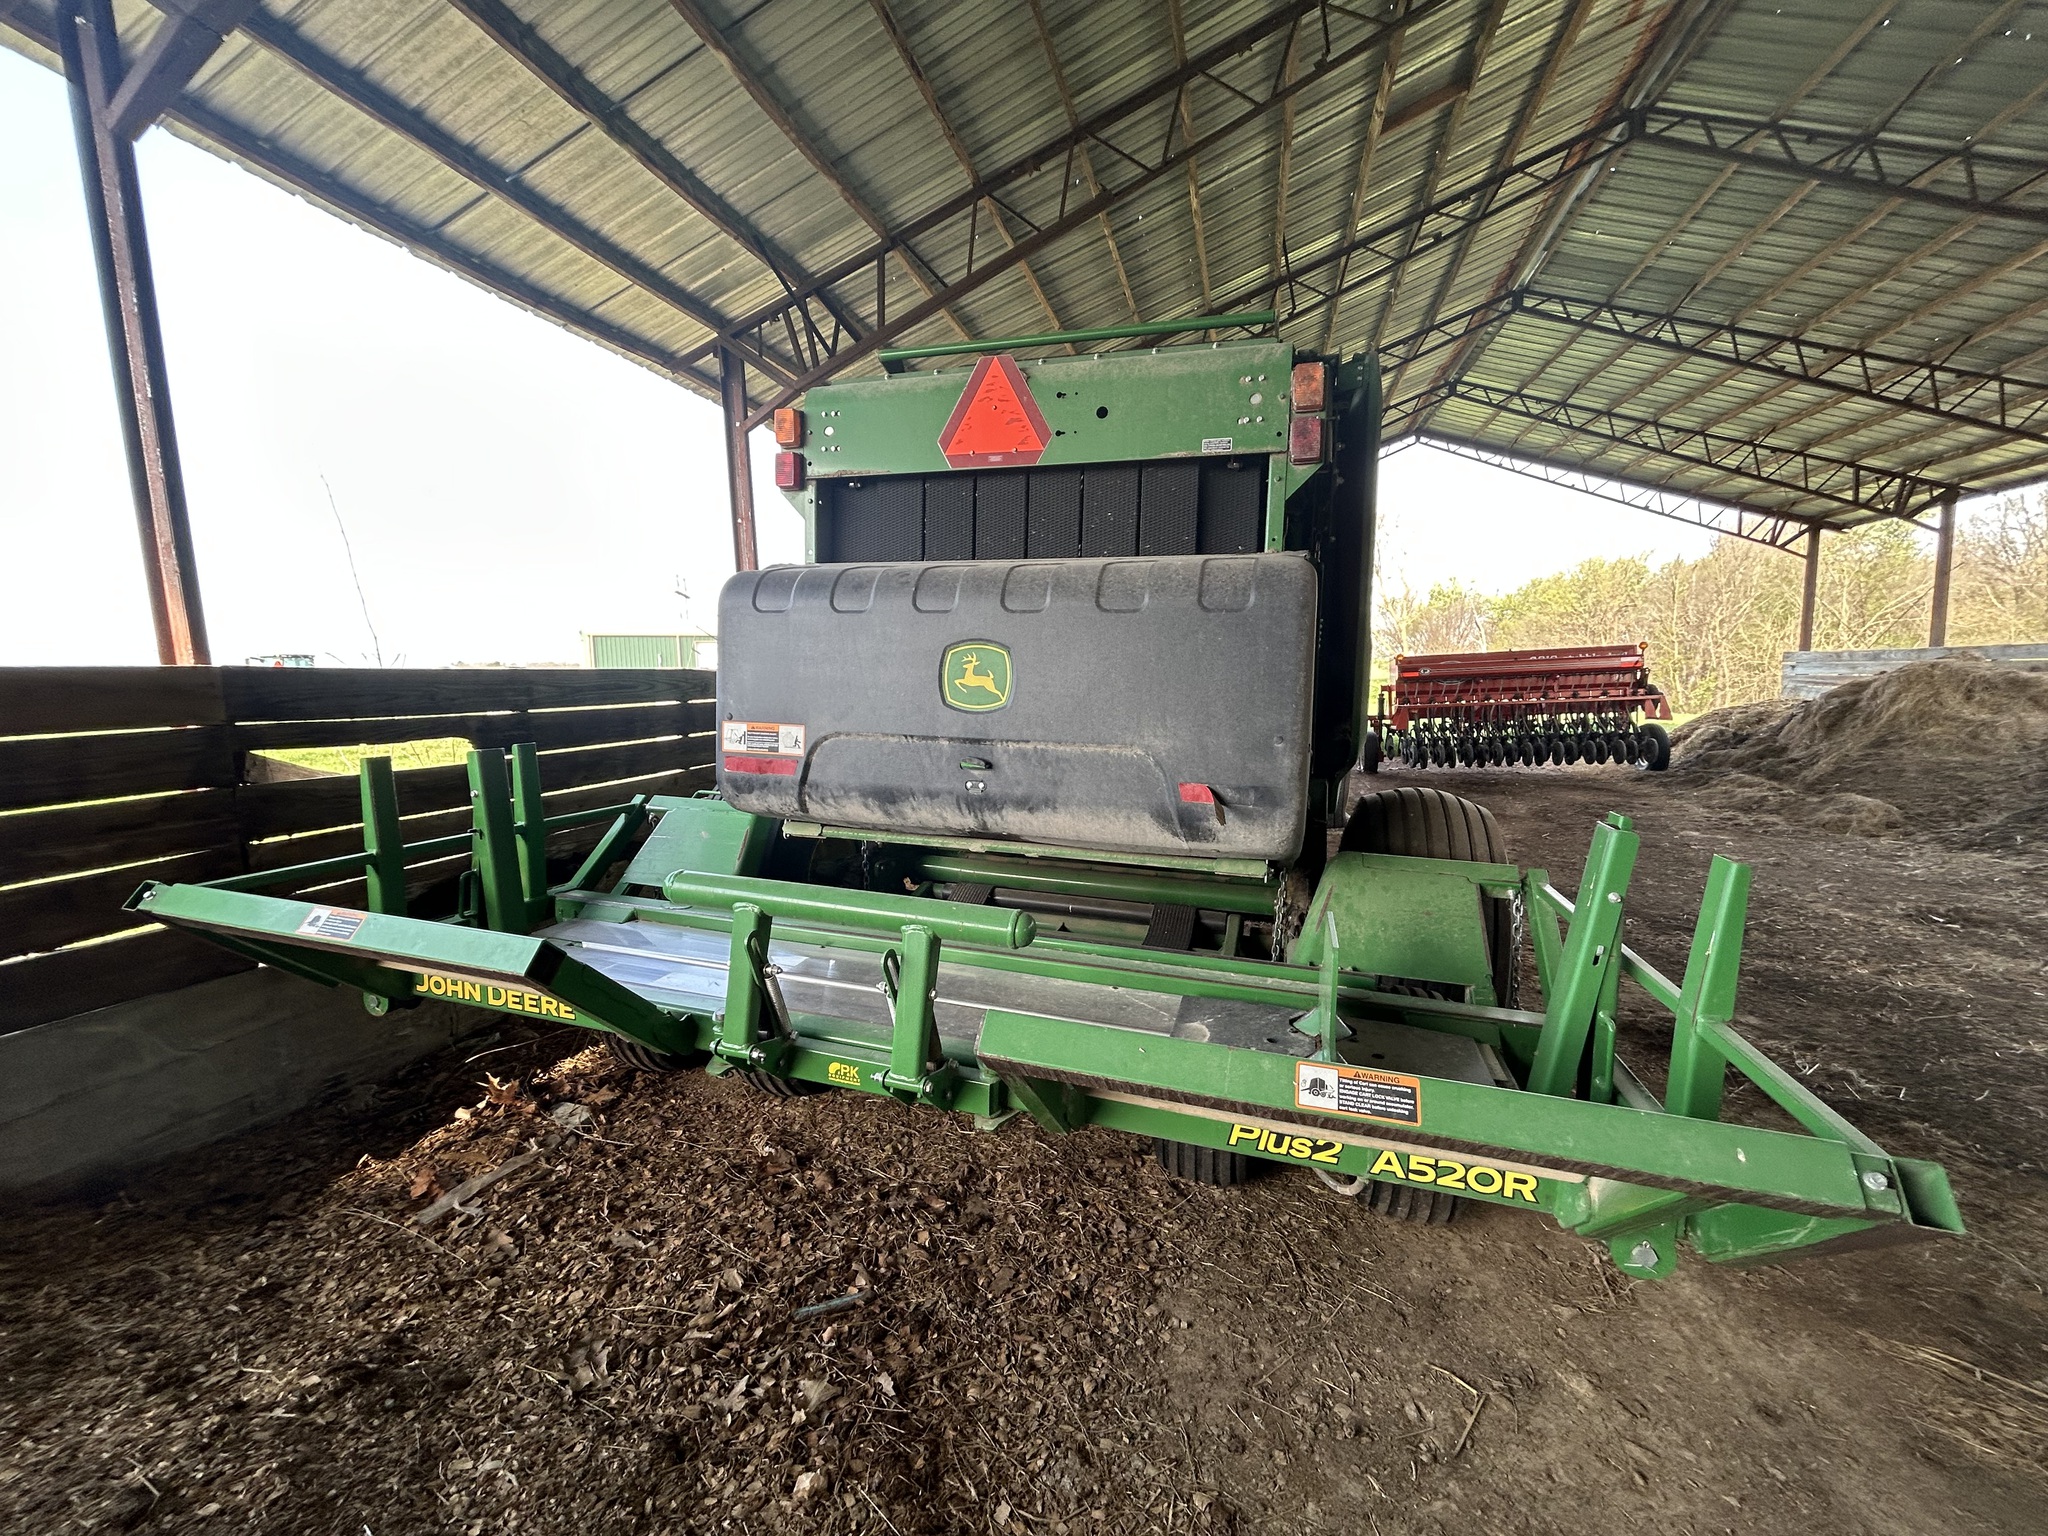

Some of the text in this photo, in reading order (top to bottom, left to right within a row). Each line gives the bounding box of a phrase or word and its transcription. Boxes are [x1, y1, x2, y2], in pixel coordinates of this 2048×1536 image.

[416, 974, 576, 1020] JOHN DEERE
[840, 1064, 859, 1079] PK
[1361, 1073, 1400, 1084] WARNING
[1227, 1123, 1344, 1165] Plus2
